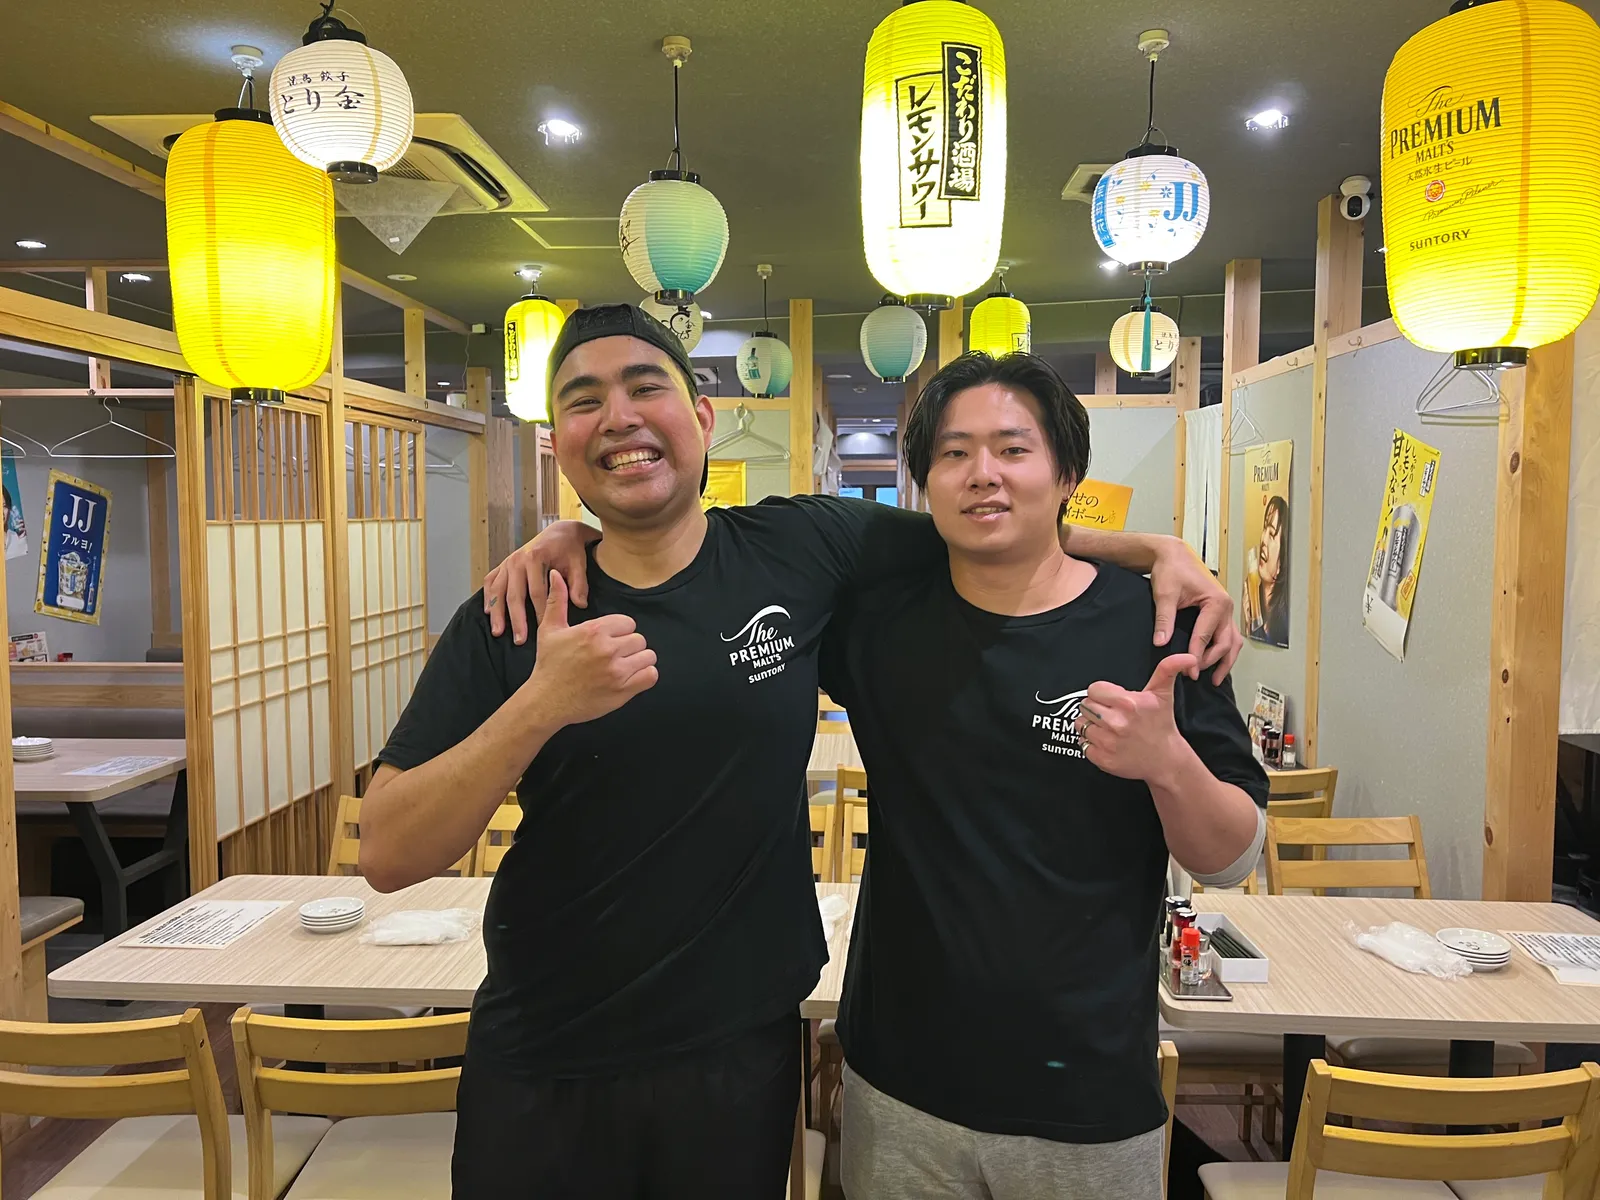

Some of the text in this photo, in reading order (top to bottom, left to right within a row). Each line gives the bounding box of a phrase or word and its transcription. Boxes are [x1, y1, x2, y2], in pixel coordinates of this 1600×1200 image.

[1407, 85, 1464, 118] The
[948, 51, 977, 193] こだわり酒場
[1391, 97, 1501, 160] PREMIUM
[906, 82, 940, 220] レモンサワー
[1416, 140, 1454, 164] MALT'S
[1163, 181, 1201, 222] JJ
[1409, 228, 1471, 251] SUNTORY
[1253, 462, 1279, 483] PREMIUM
[62, 493, 97, 533] JJ
[720, 604, 791, 648] The
[729, 636, 795, 666] PREMIUM
[752, 653, 782, 669] MALT'S
[748, 662, 786, 684] SUNTORY
[1035, 689, 1088, 720] Th
[1032, 714, 1080, 735] PREM
[1051, 731, 1080, 745] MALT'
